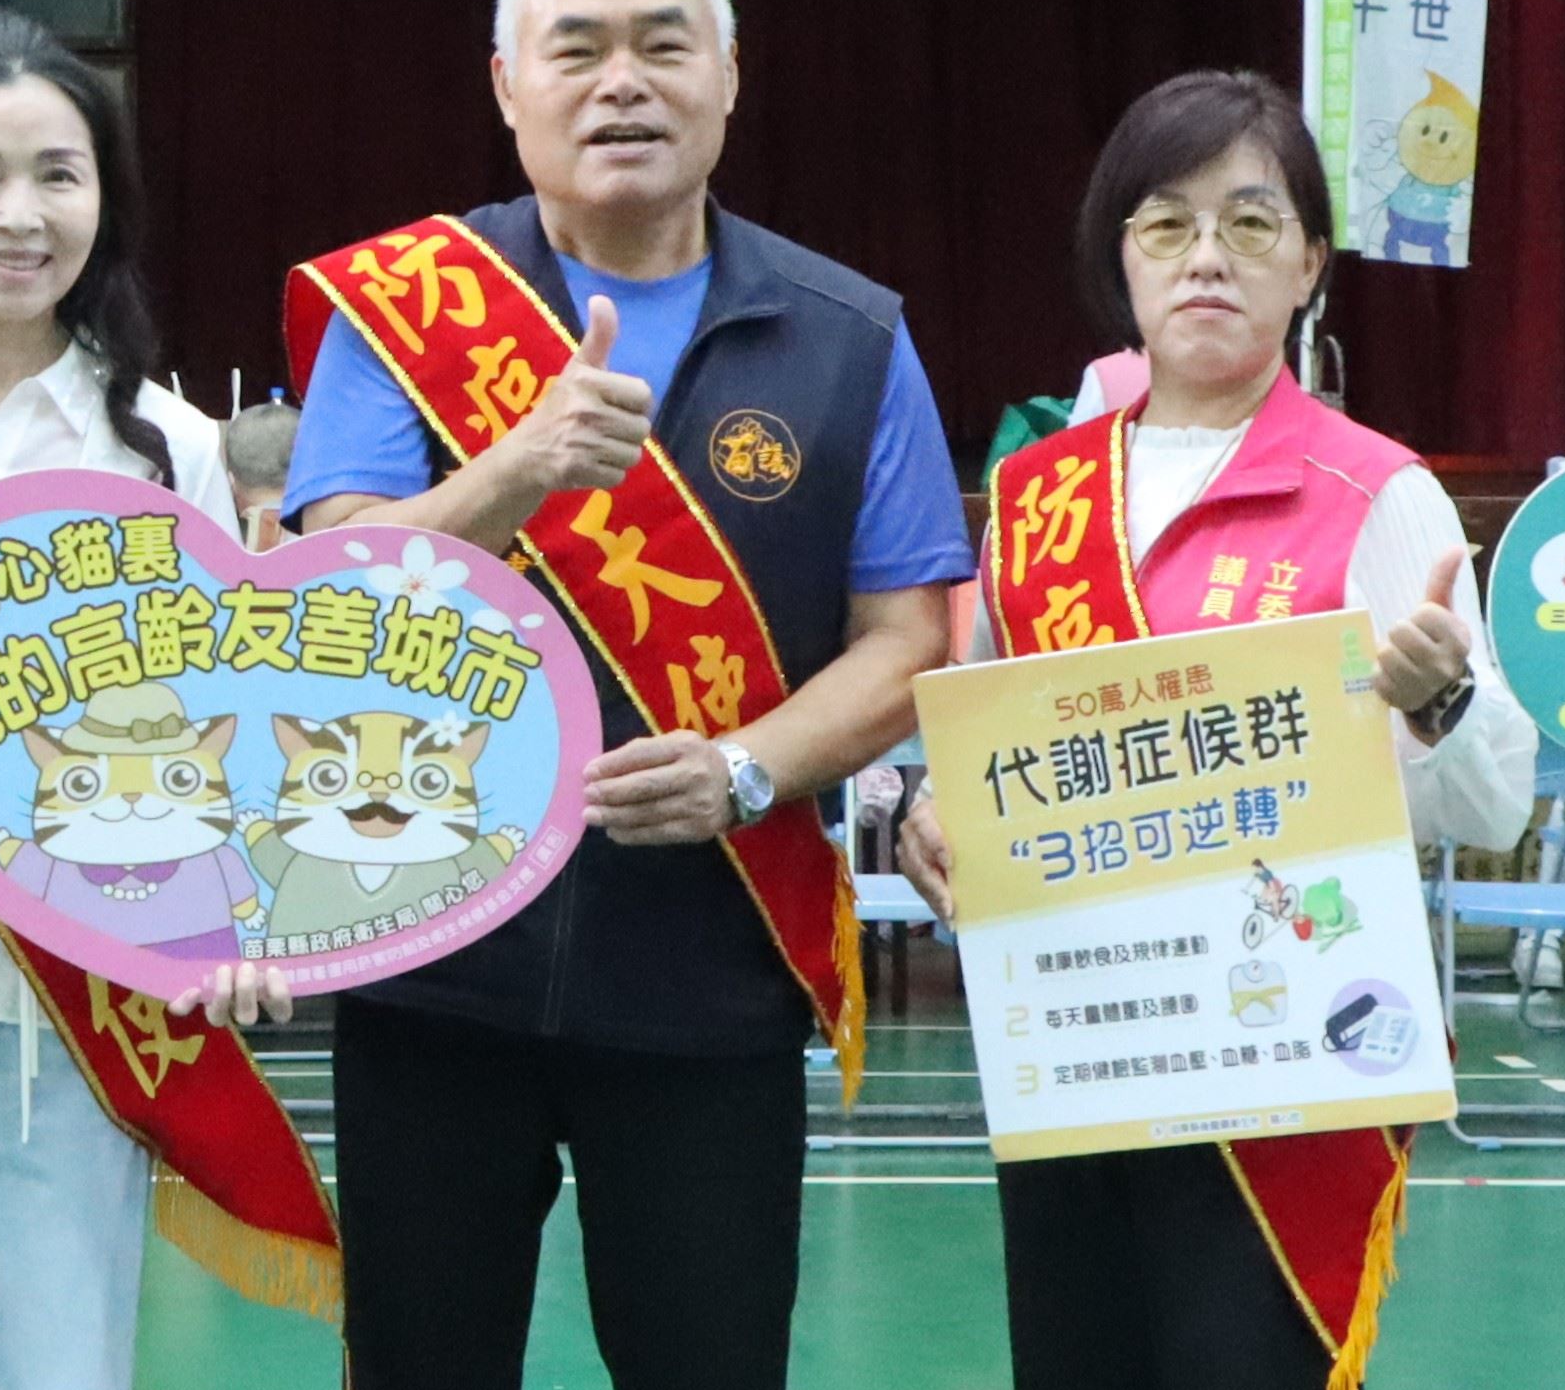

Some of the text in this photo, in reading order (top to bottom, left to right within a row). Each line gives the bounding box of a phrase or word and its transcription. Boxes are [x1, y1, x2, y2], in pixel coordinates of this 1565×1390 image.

[1054, 663, 1215, 722] 50萬人罹患
[983, 686, 1312, 819] 代謝症候群
[242, 868, 489, 961] 苗栗縣政府衛生局 關心您
[1006, 1005, 1030, 1038] 2
[1016, 1063, 1040, 1096] 3
